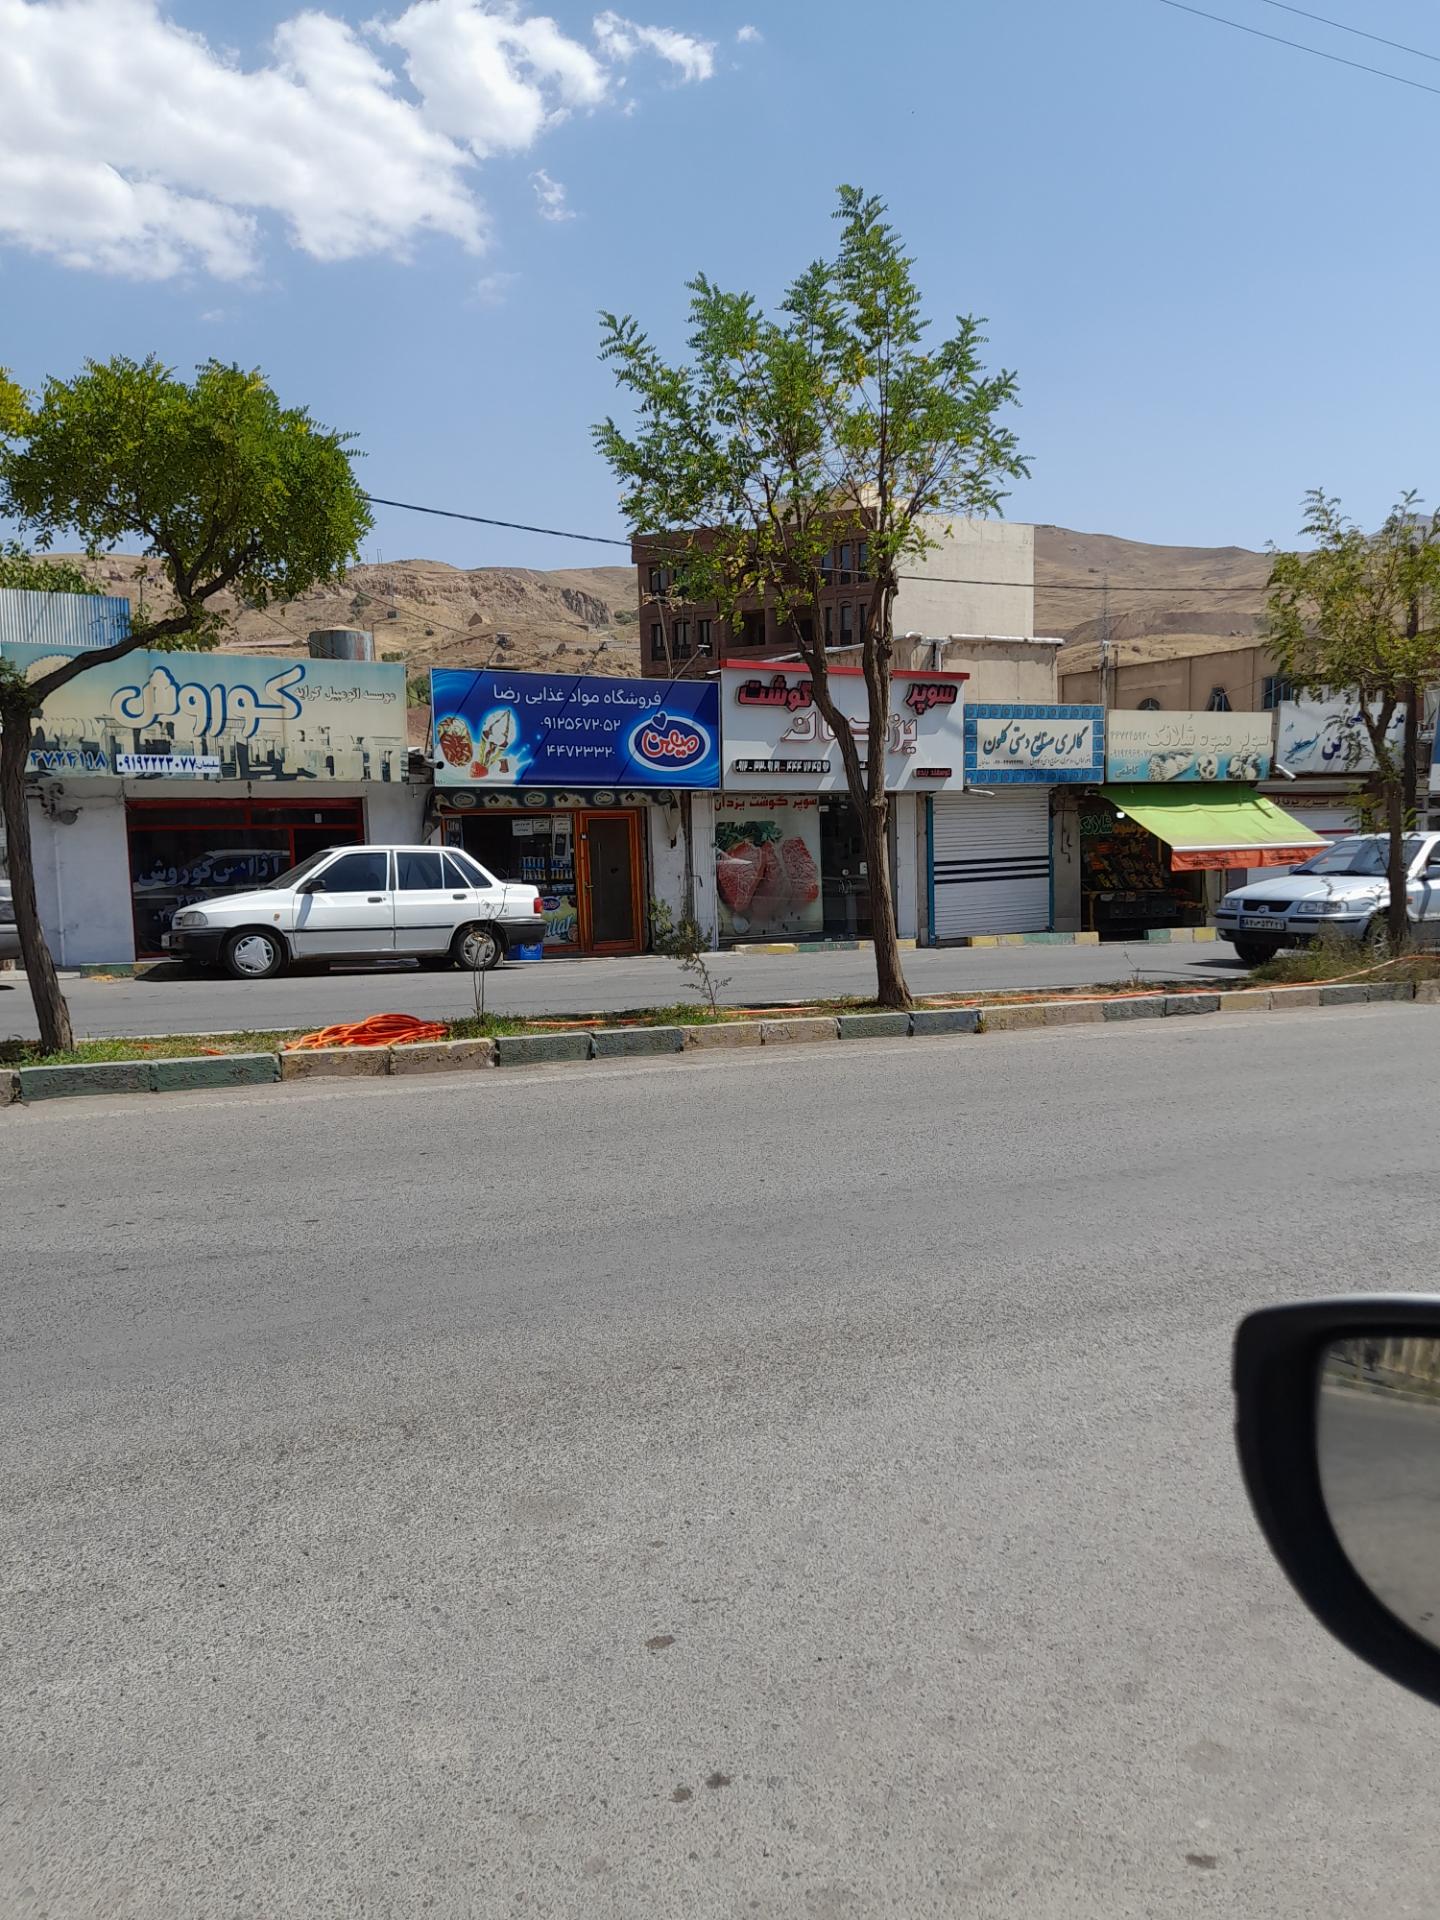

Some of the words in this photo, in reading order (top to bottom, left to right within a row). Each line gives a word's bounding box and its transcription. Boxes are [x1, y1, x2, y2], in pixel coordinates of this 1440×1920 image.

[110, 664, 304, 738] کوروش
[493, 684, 520, 704] رضا
[525, 687, 564, 704] غذایی
[568, 687, 599, 704] مواد
[603, 688, 662, 709] فروشگاه
[738, 675, 813, 712] گوشت
[906, 684, 957, 715] سوپر
[540, 717, 621, 731] ۰۹۱۲۵۶۷۲۰۵۲
[642, 730, 700, 758] میهن
[1009, 726, 1029, 755] دستی
[1030, 731, 1055, 757] صنایع
[1055, 725, 1089, 755] گالری
[1199, 734, 1231, 754] میوه
[1237, 732, 1269, 754] سوپر
[547, 744, 615, 758] ۴۴۷۲۳۳۲۰
[714, 795, 745, 811] یزدان
[749, 794, 788, 810] گوشت
[792, 798, 818, 812] سوپر
[138, 859, 214, 887] کوروش
[213, 852, 280, 883] آژانس
